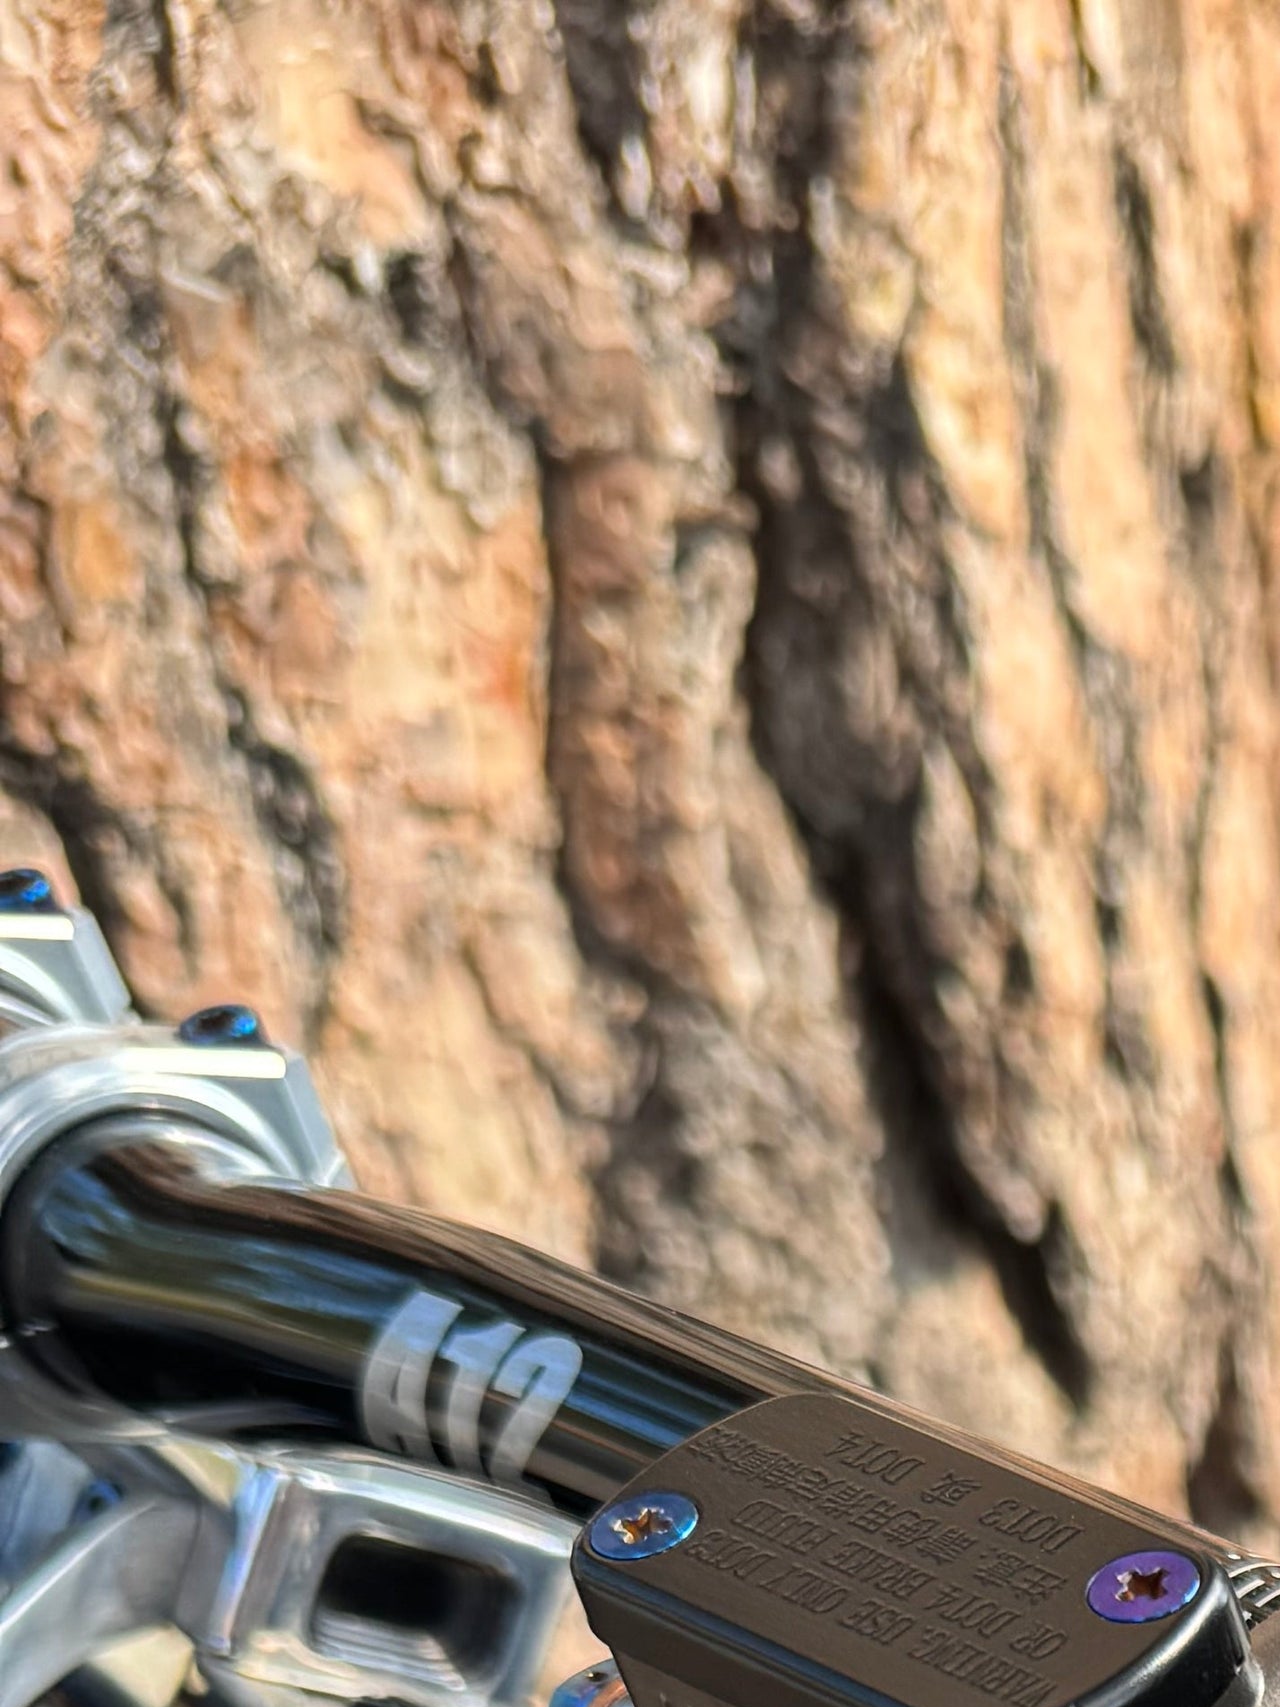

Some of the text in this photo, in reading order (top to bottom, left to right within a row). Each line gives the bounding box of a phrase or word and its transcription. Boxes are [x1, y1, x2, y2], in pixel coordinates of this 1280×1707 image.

[817, 1429, 1086, 1555] DOT3 或 DOT4
[679, 1528, 777, 1580] DOT3
[725, 1497, 1073, 1662] OR DOT4 BRAKE FLUID
[756, 1562, 856, 1617] ONLY
[833, 1597, 920, 1645] USE
